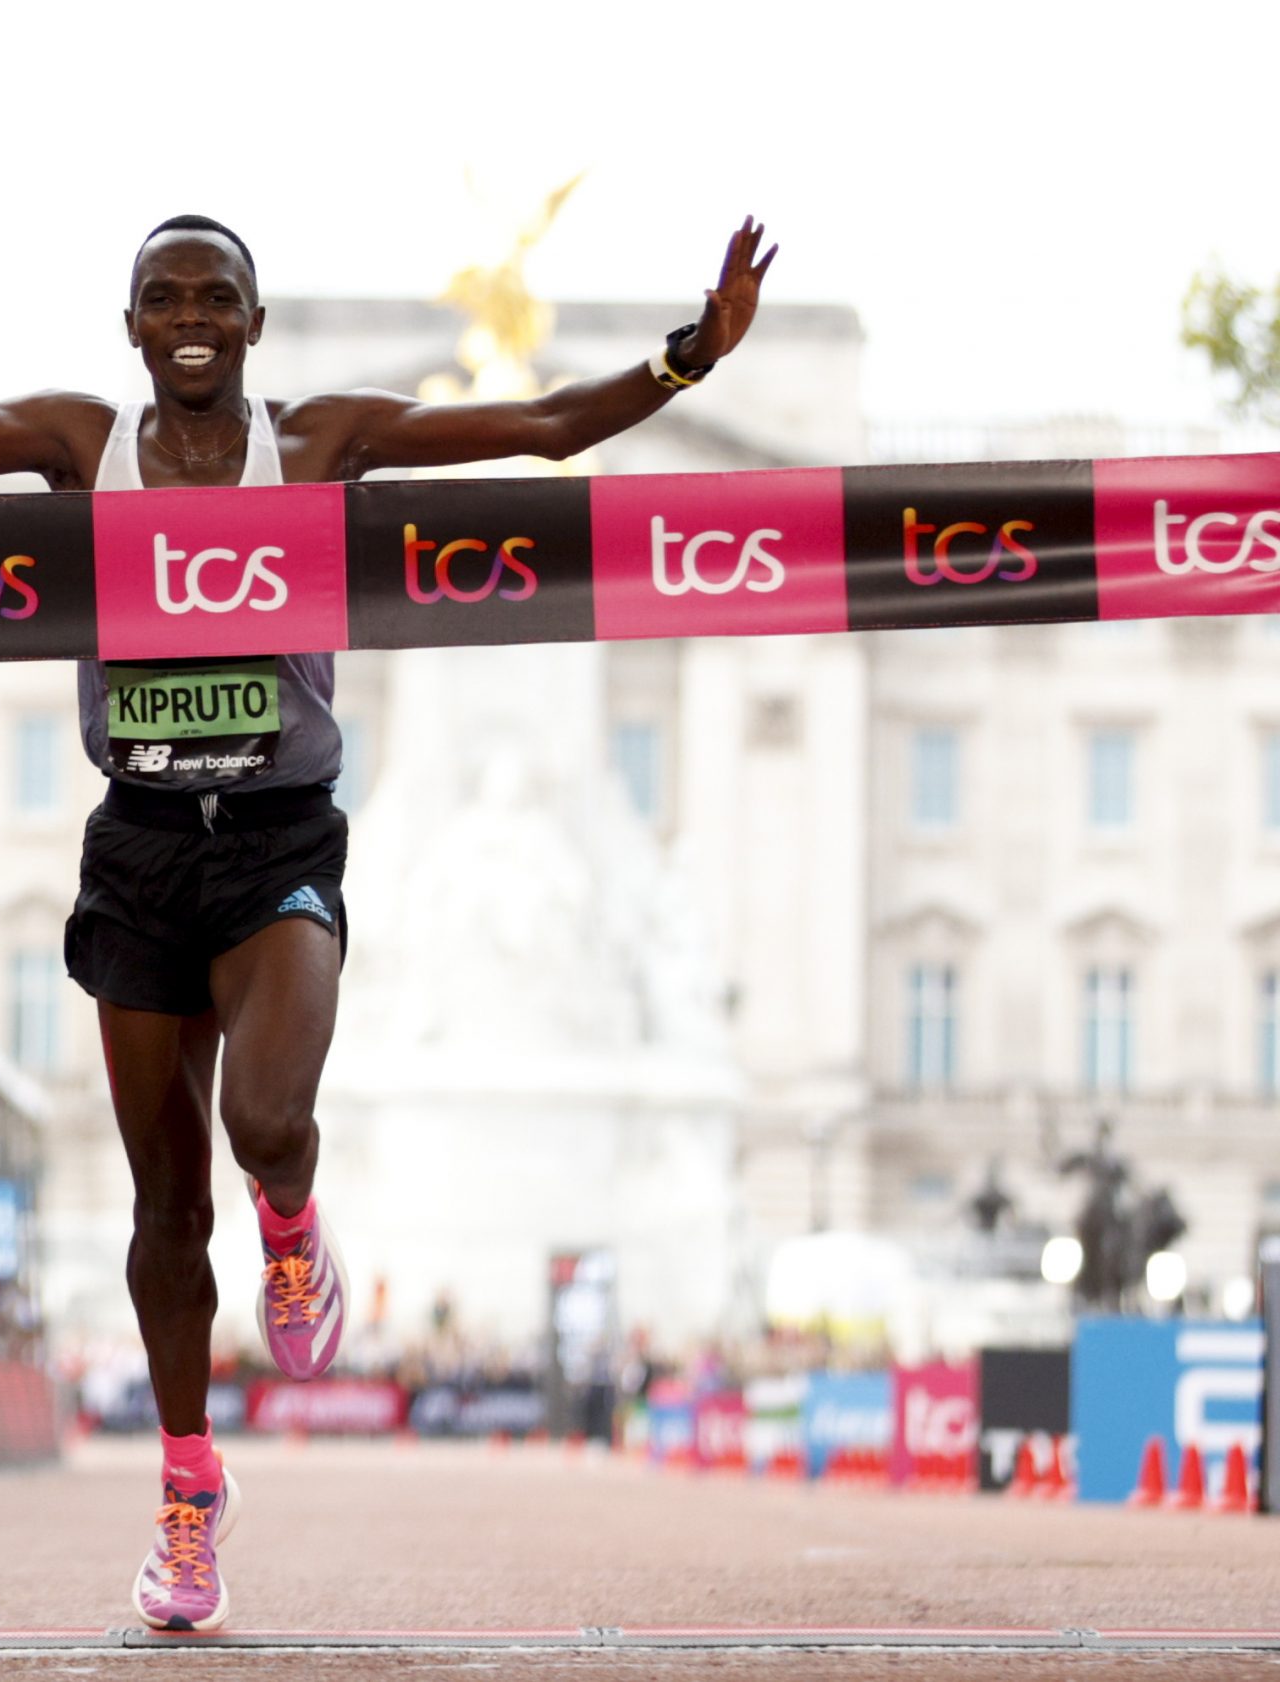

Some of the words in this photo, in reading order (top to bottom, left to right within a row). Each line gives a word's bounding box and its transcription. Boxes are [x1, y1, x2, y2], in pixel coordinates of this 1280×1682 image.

[153, 532, 289, 615] tcs
[403, 522, 540, 605] tcs
[650, 515, 789, 597] tcs
[902, 507, 1040, 587] tcs
[1153, 499, 1280, 575] tcs
[118, 680, 268, 724] KIPRUTO
[173, 757, 205, 771] new
[206, 754, 265, 770] balance
[277, 899, 333, 923] adidas
